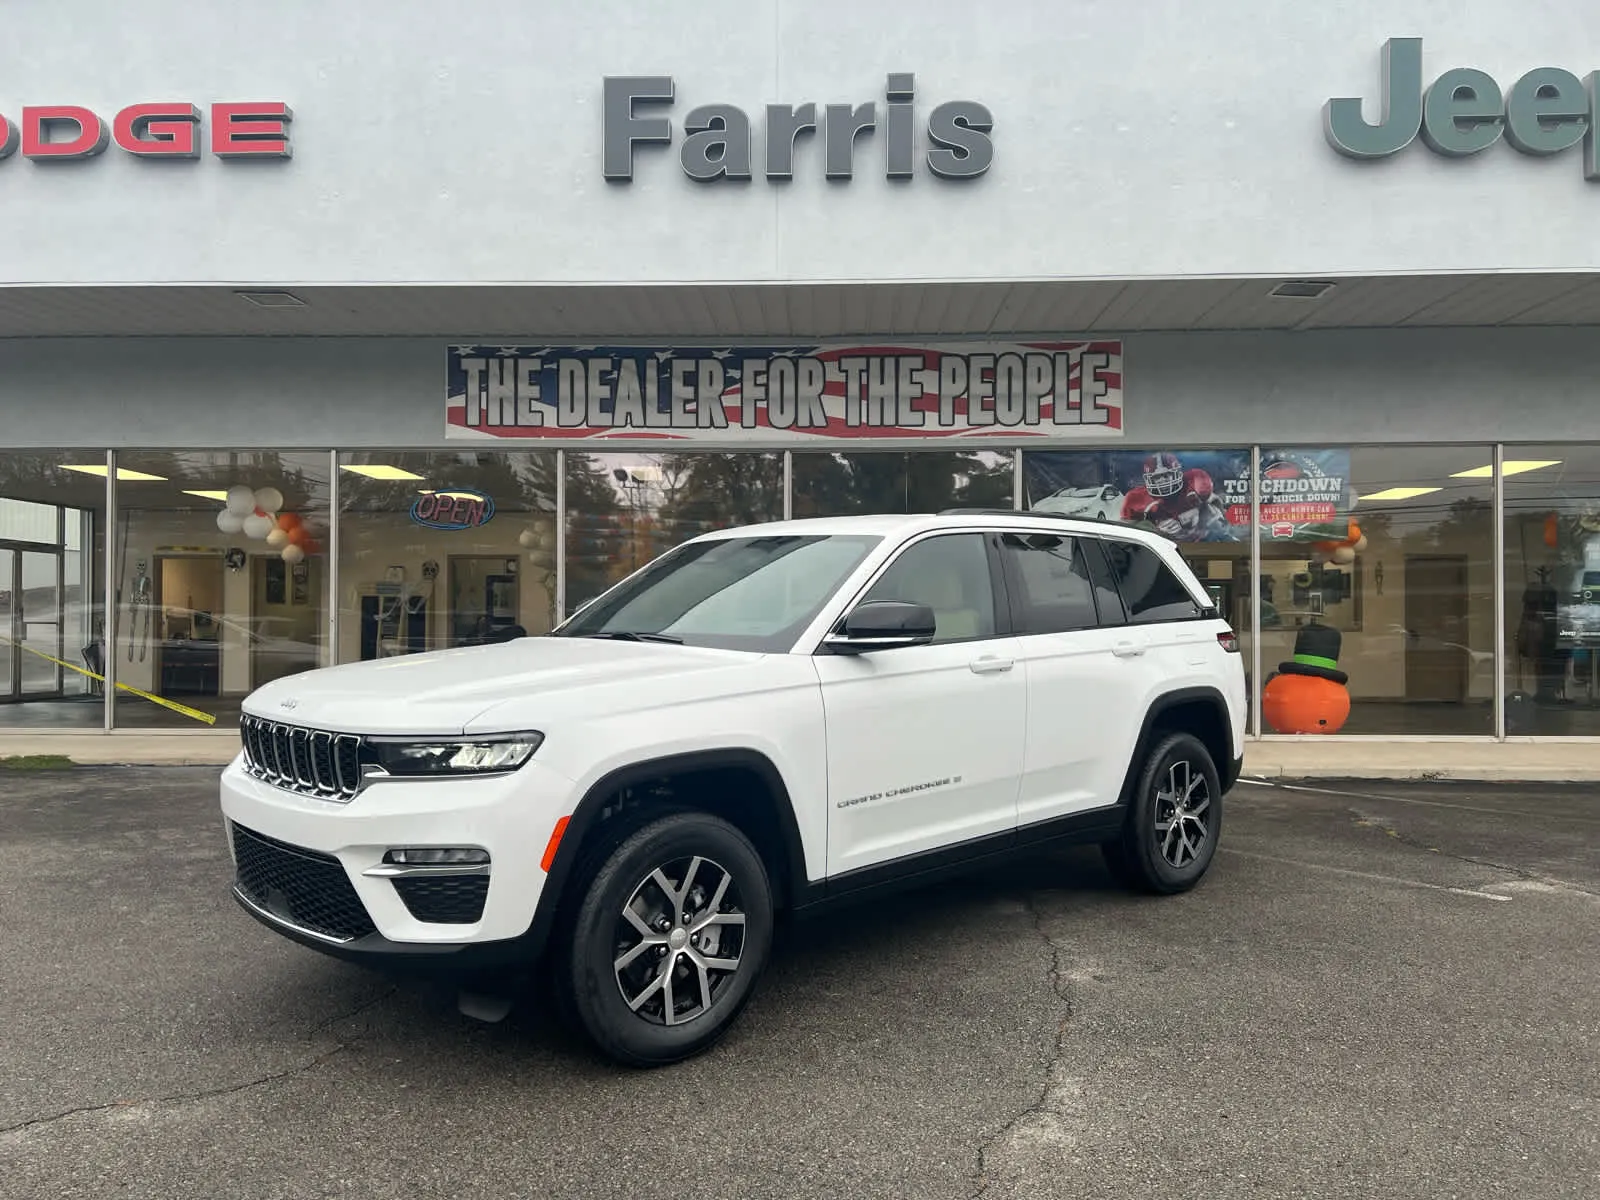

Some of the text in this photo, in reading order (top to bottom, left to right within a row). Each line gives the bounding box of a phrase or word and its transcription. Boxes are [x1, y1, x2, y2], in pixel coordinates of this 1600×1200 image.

[0, 102, 293, 160] DGE
[602, 73, 993, 182] Farris
[1322, 38, 1600, 181] Jee
[460, 352, 1109, 430] THE DEALER FOR THE PEOPLE
[1224, 478, 1342, 493] TOCHDOWN
[1225, 495, 1245, 503] FOR
[1273, 494, 1303, 503] MUCH
[1307, 493, 1341, 501] DOWN!
[417, 493, 486, 528] OPEN
[836, 778, 950, 809] GRAND CHEROKEE
